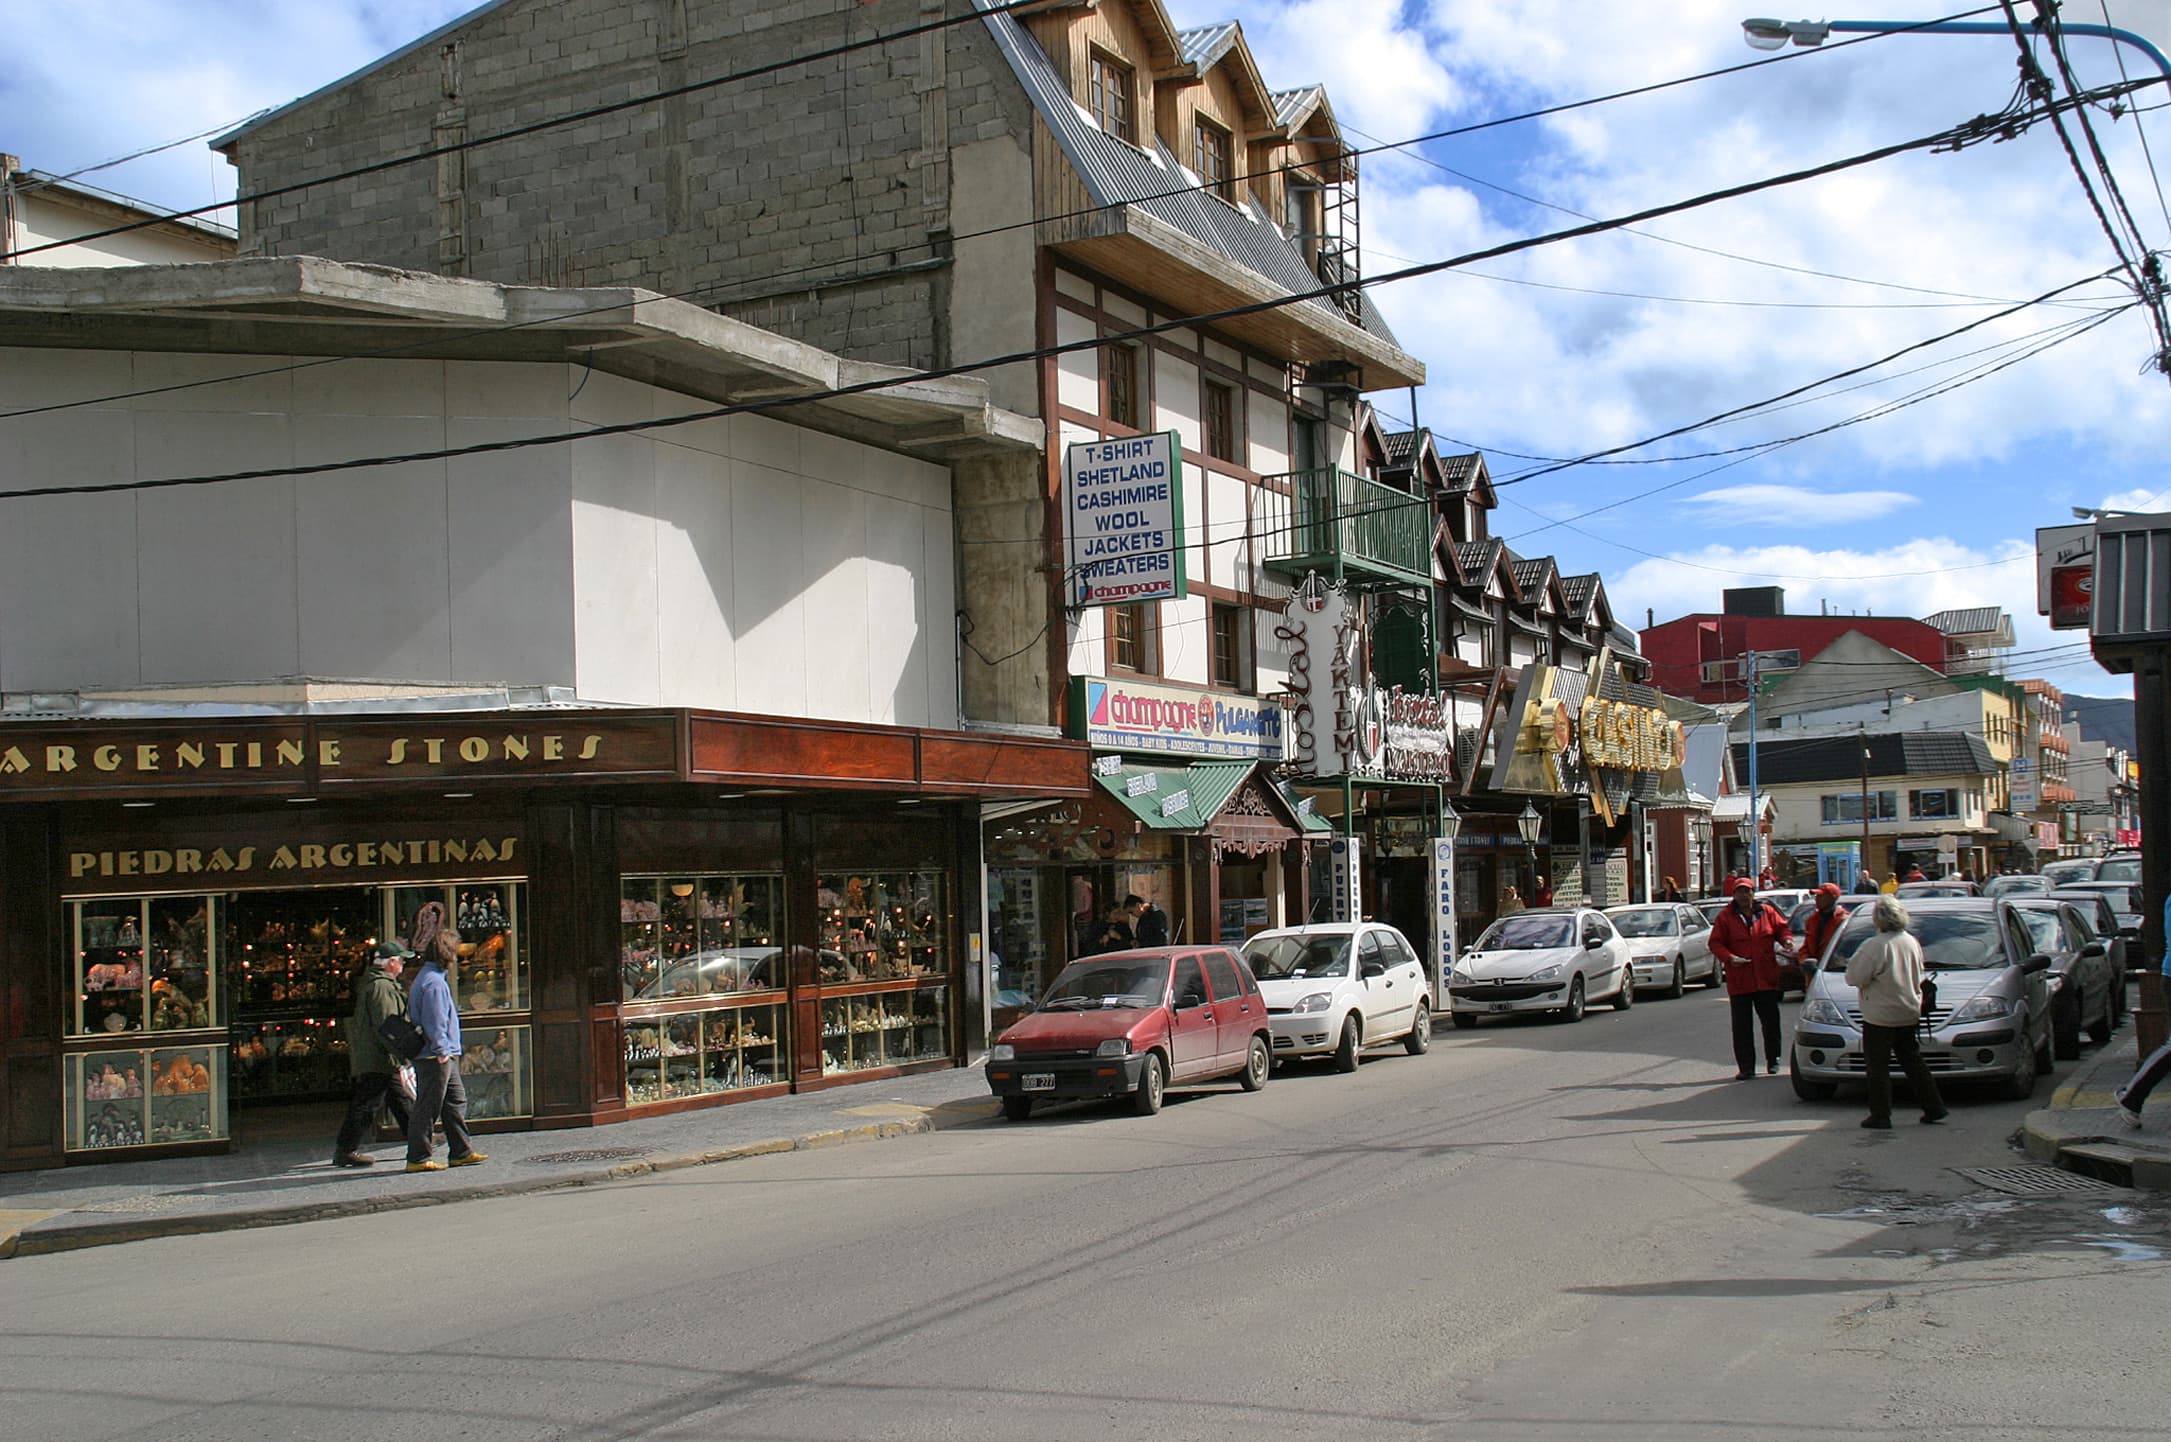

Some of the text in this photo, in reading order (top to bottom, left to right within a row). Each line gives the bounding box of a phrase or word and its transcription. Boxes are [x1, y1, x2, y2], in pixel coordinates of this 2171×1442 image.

[1086, 440, 1153, 463] T-SHIRT
[1077, 461, 1164, 487] SHETLAND
[1077, 484, 1167, 510] CASHIMIRE
[1095, 510, 1149, 531] WOOL
[1084, 531, 1163, 556] JACKETS
[1080, 553, 1169, 579] SWEATERS
[1111, 690, 1197, 733] champagne
[1330, 624, 1355, 774] YAKTEMI
[1581, 695, 1673, 771] CASINO
[0, 734, 602, 774] ARGENTINE STONES
[71, 838, 518, 877] PIEDRAS ARGENTINAS
[1441, 869, 1452, 988] FARO LOBOS
